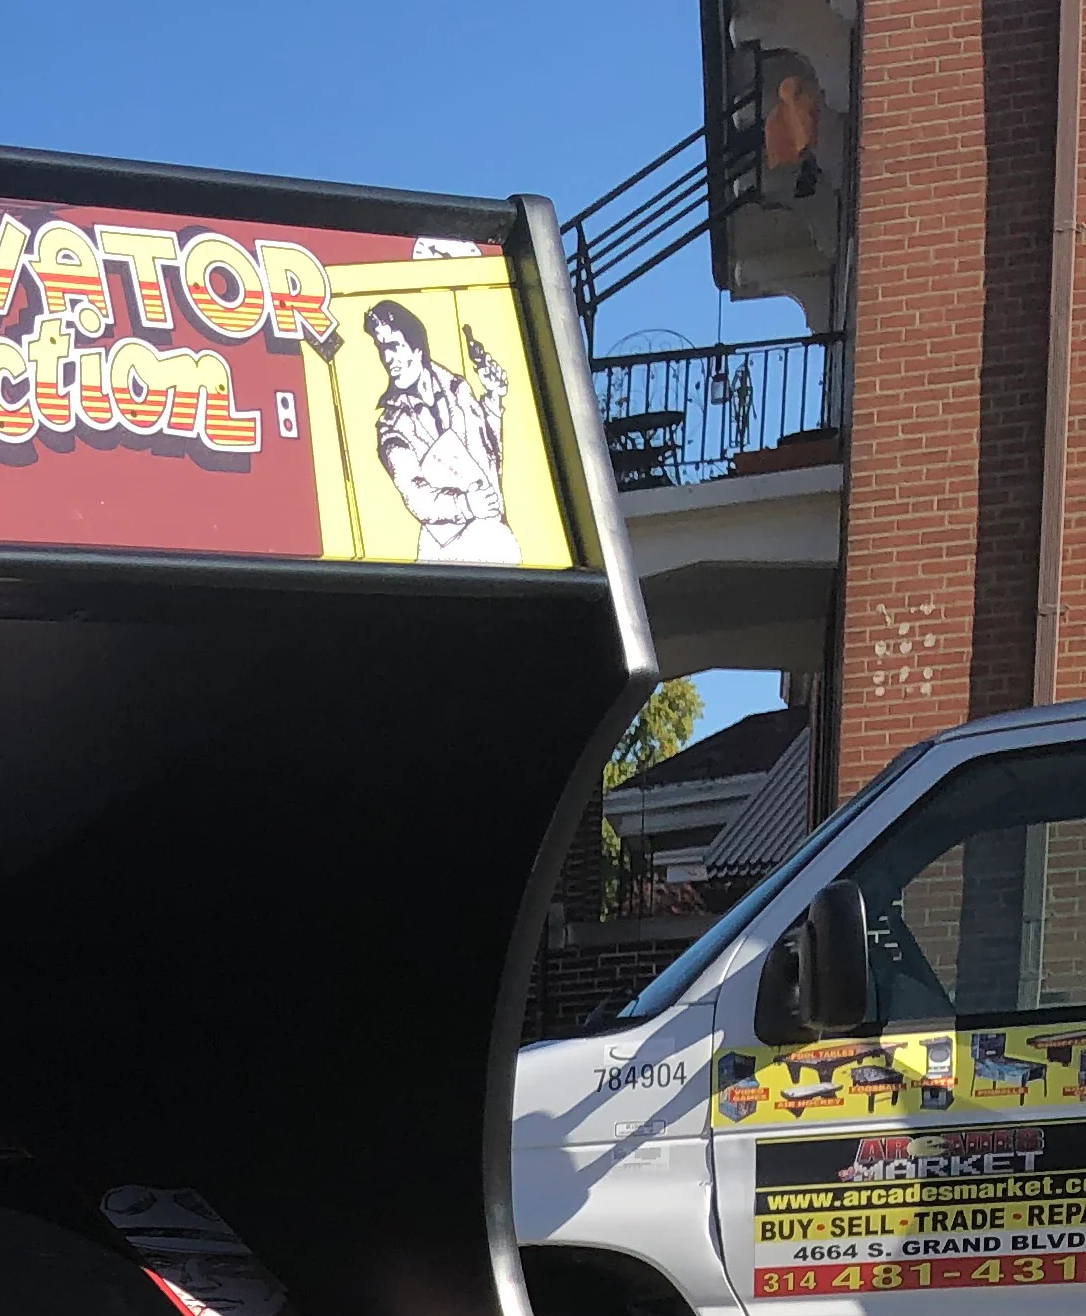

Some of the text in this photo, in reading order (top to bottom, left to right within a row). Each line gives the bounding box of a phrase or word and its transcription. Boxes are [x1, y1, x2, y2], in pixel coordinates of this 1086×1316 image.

[594, 1061, 686, 1092] 784904
[854, 1151, 1043, 1181] MARKET
[767, 1175, 1086, 1211] www.arcadesmarket.c
[760, 1218, 814, 1242] BUY
[830, 1214, 894, 1238] SELL
[914, 1207, 1005, 1233] TRADE
[794, 1233, 1085, 1262] 4664 S. GRAND BLVD
[764, 1271, 816, 1292] 314
